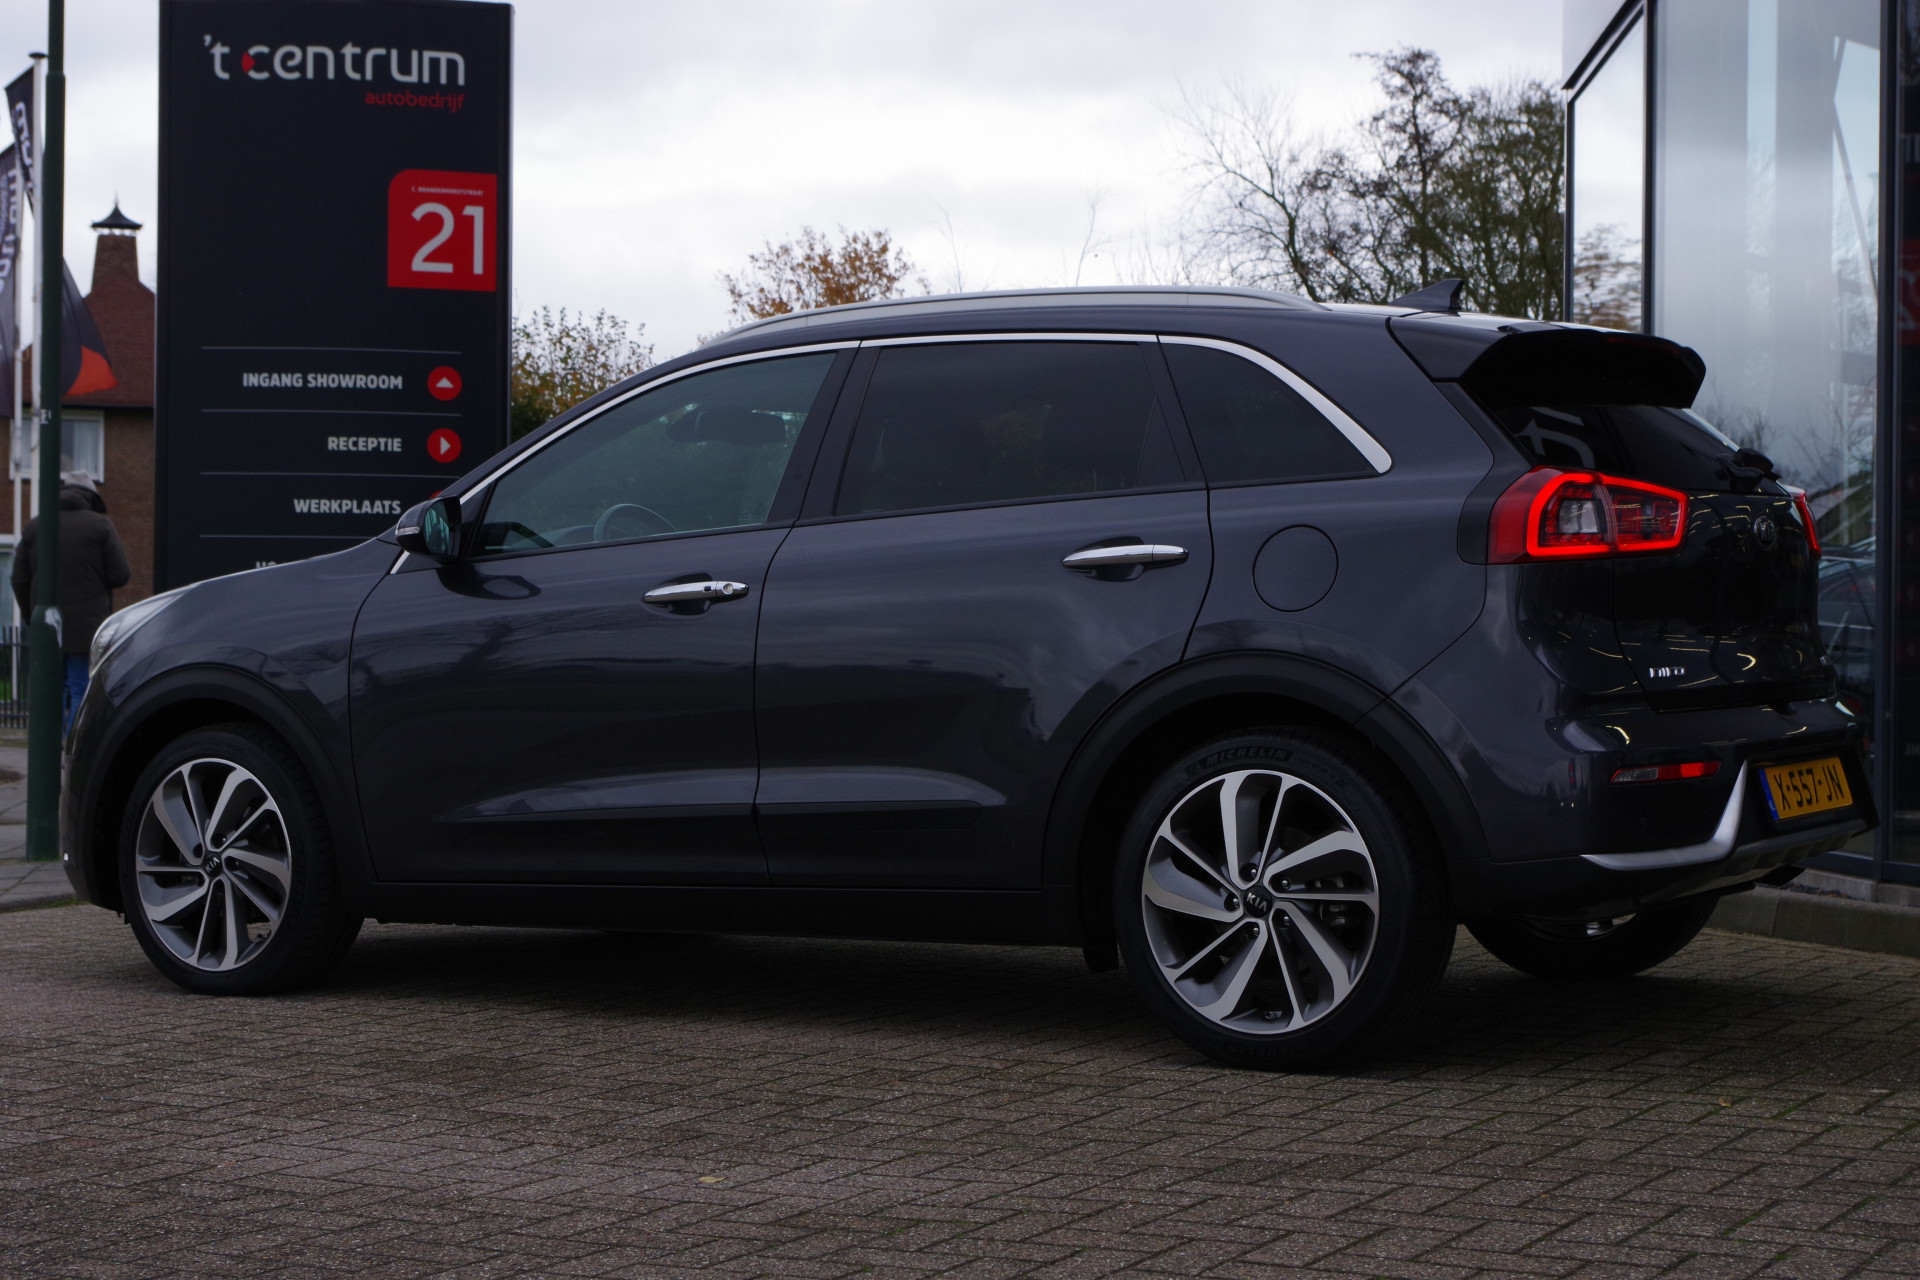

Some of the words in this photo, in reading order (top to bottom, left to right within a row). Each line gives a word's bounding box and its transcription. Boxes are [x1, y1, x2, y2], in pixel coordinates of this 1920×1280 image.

[241, 42, 466, 86] centrum
[365, 91, 465, 112] autobedrijf
[411, 202, 484, 275] 21
[243, 373, 303, 388] INGANG
[307, 374, 402, 390] SHOWROOM
[328, 437, 402, 452] RECEPTIE
[294, 499, 401, 515] WERKPLAATS
[1206, 746, 1288, 765] MICHELIN
[1773, 764, 1845, 811] X-557-JN
[204, 857, 221, 874] KIA
[1246, 891, 1268, 912] KIA
